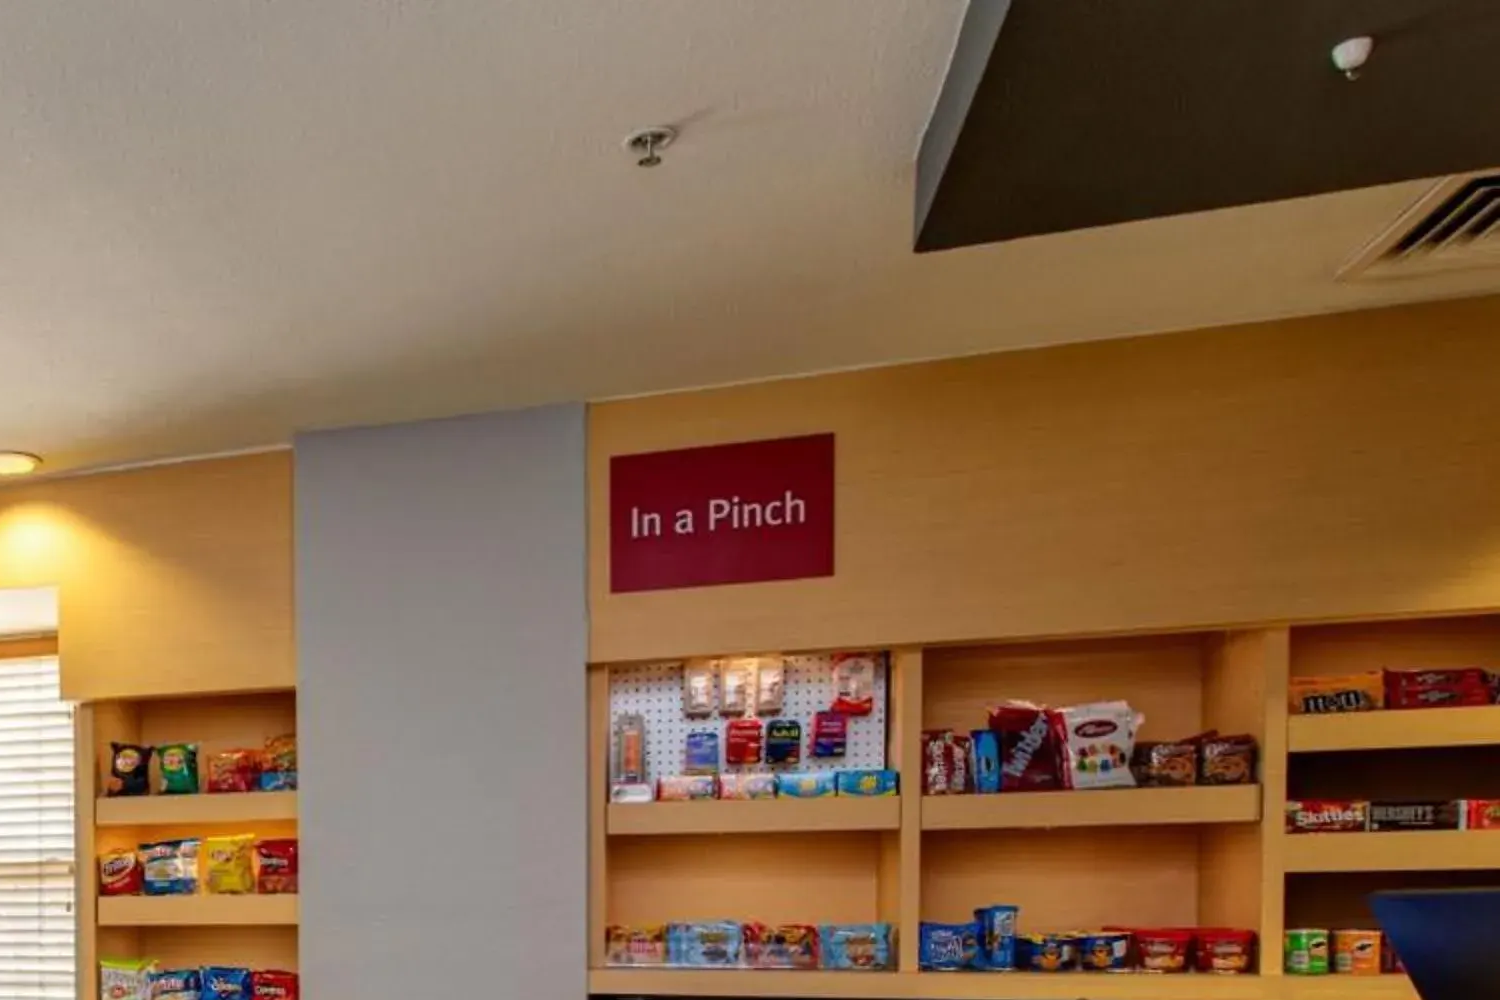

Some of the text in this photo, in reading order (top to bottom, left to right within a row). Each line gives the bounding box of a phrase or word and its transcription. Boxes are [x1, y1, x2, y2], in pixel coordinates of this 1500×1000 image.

[631, 490, 806, 538] In a Pinch
[1295, 807, 1365, 826] Skittles
